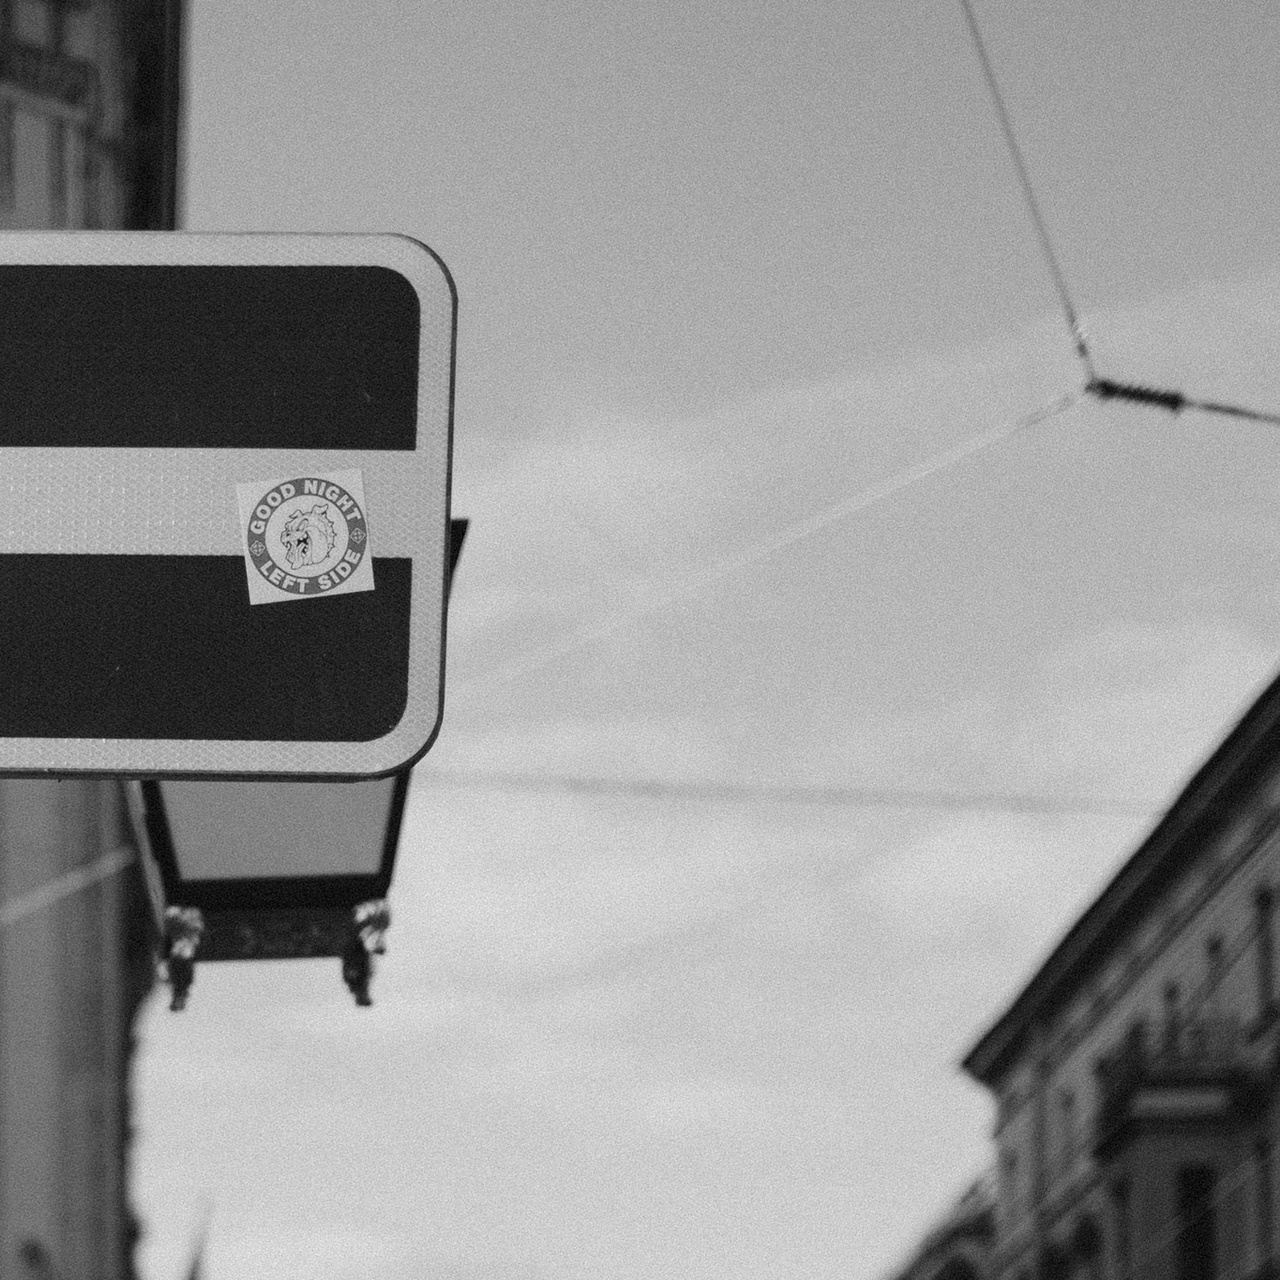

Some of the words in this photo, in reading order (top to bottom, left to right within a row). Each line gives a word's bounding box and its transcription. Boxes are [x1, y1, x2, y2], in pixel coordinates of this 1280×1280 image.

[250, 482, 296, 535] GOOD
[304, 479, 362, 521] NIGHT
[259, 560, 310, 593] LEFT
[317, 548, 361, 590] SIDE
